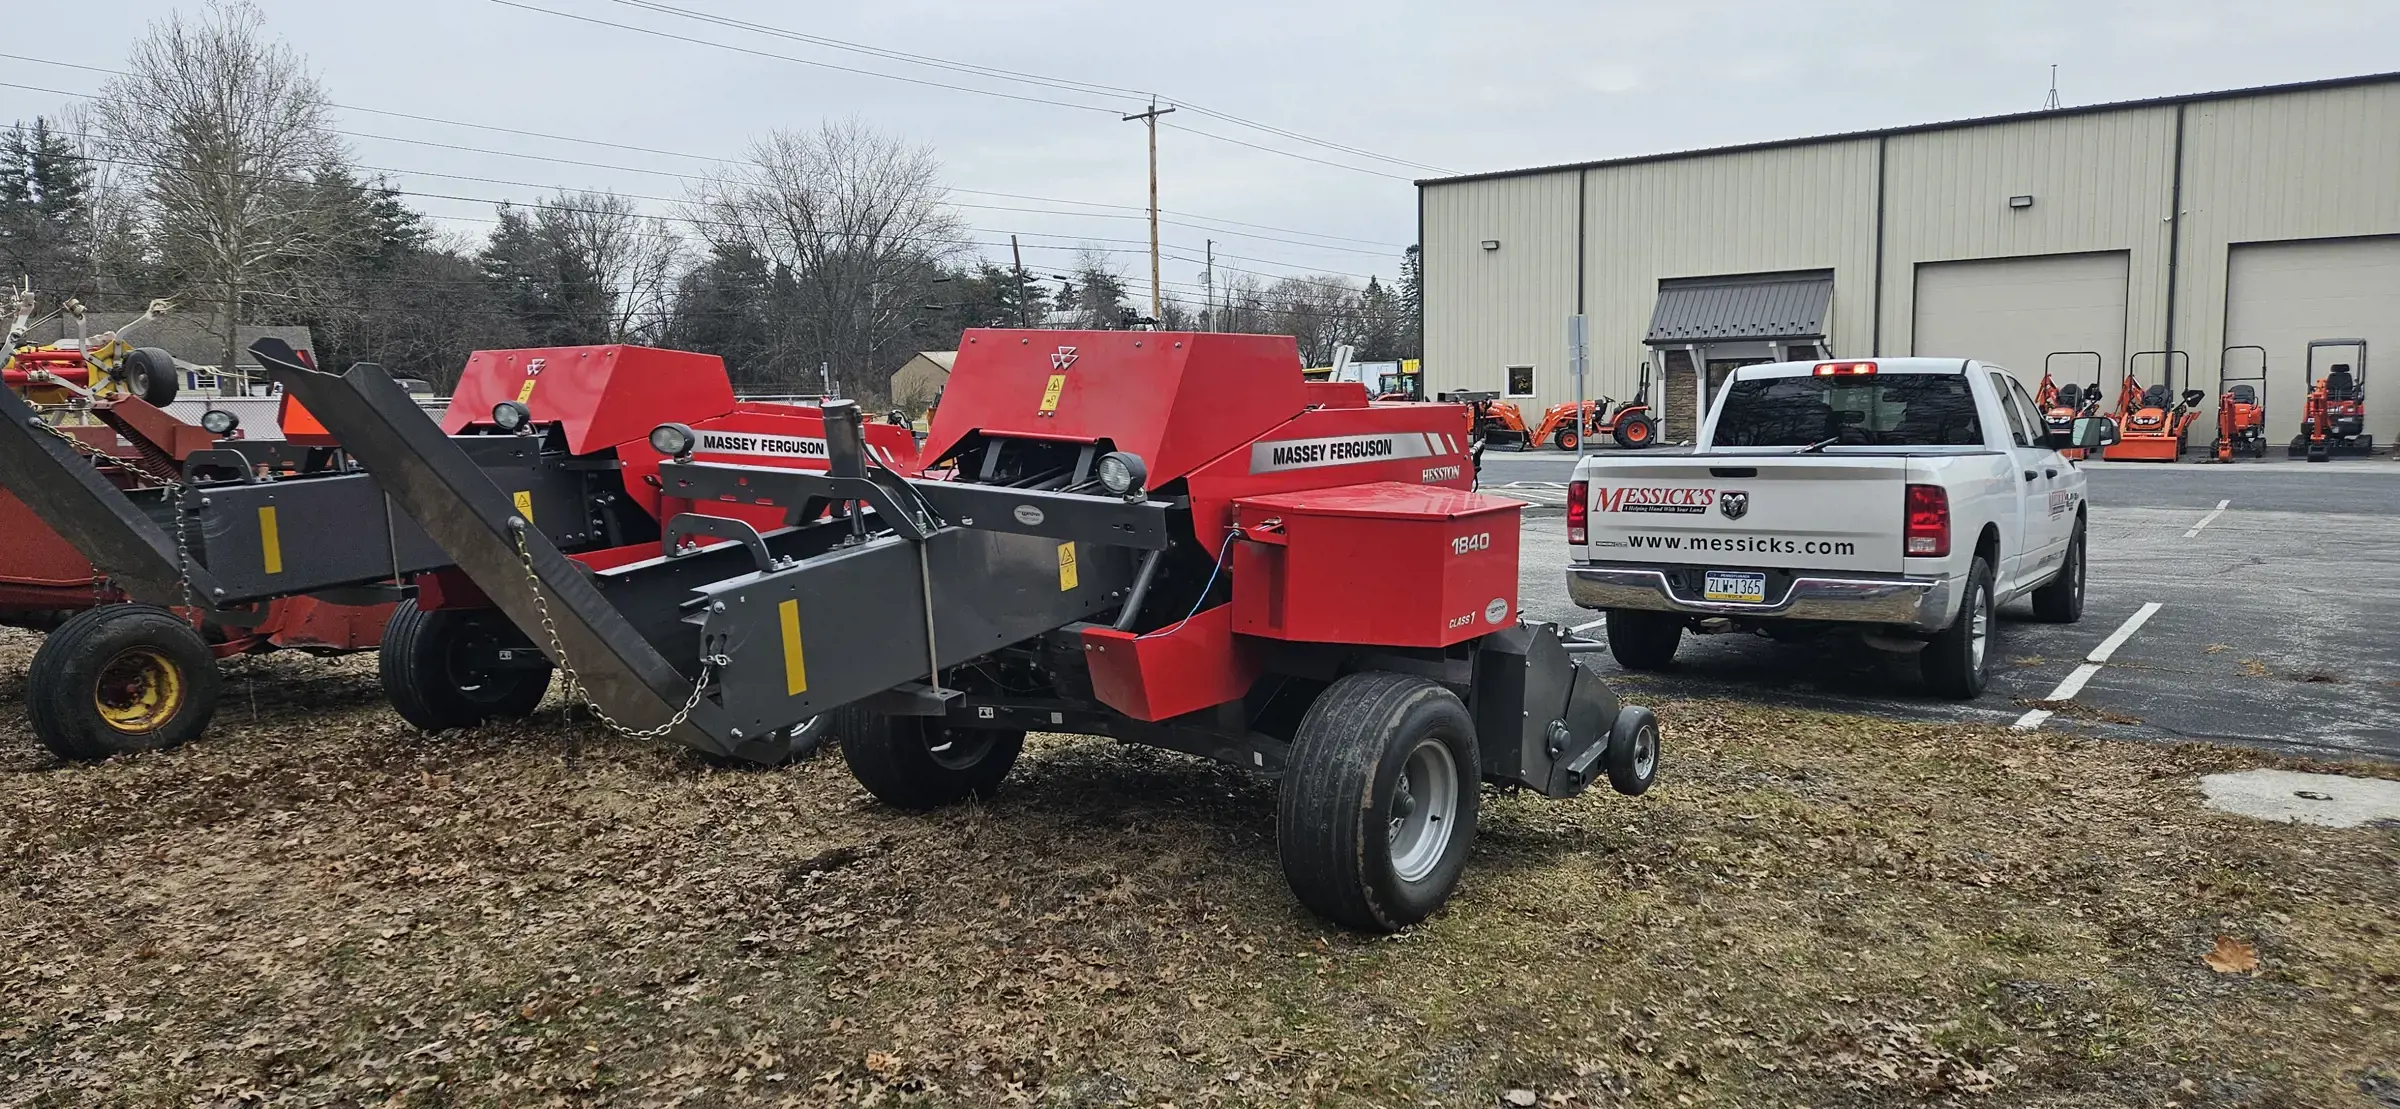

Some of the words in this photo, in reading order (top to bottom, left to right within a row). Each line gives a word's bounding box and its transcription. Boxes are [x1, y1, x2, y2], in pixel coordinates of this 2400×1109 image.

[703, 435, 757, 451] MASSEY
[761, 439, 824, 455] FERGUSON
[1273, 444, 1327, 466] MASSEY
[1330, 439, 1392, 460] FERGUSON
[1422, 465, 1460, 482] HESSTON
[1592, 487, 1716, 513] MESSICK'S
[1451, 532, 1490, 555] 1840
[1628, 535, 1855, 555] www.messicks.com
[1449, 614, 1470, 629] CLASS
[1470, 611, 1476, 625] 1
